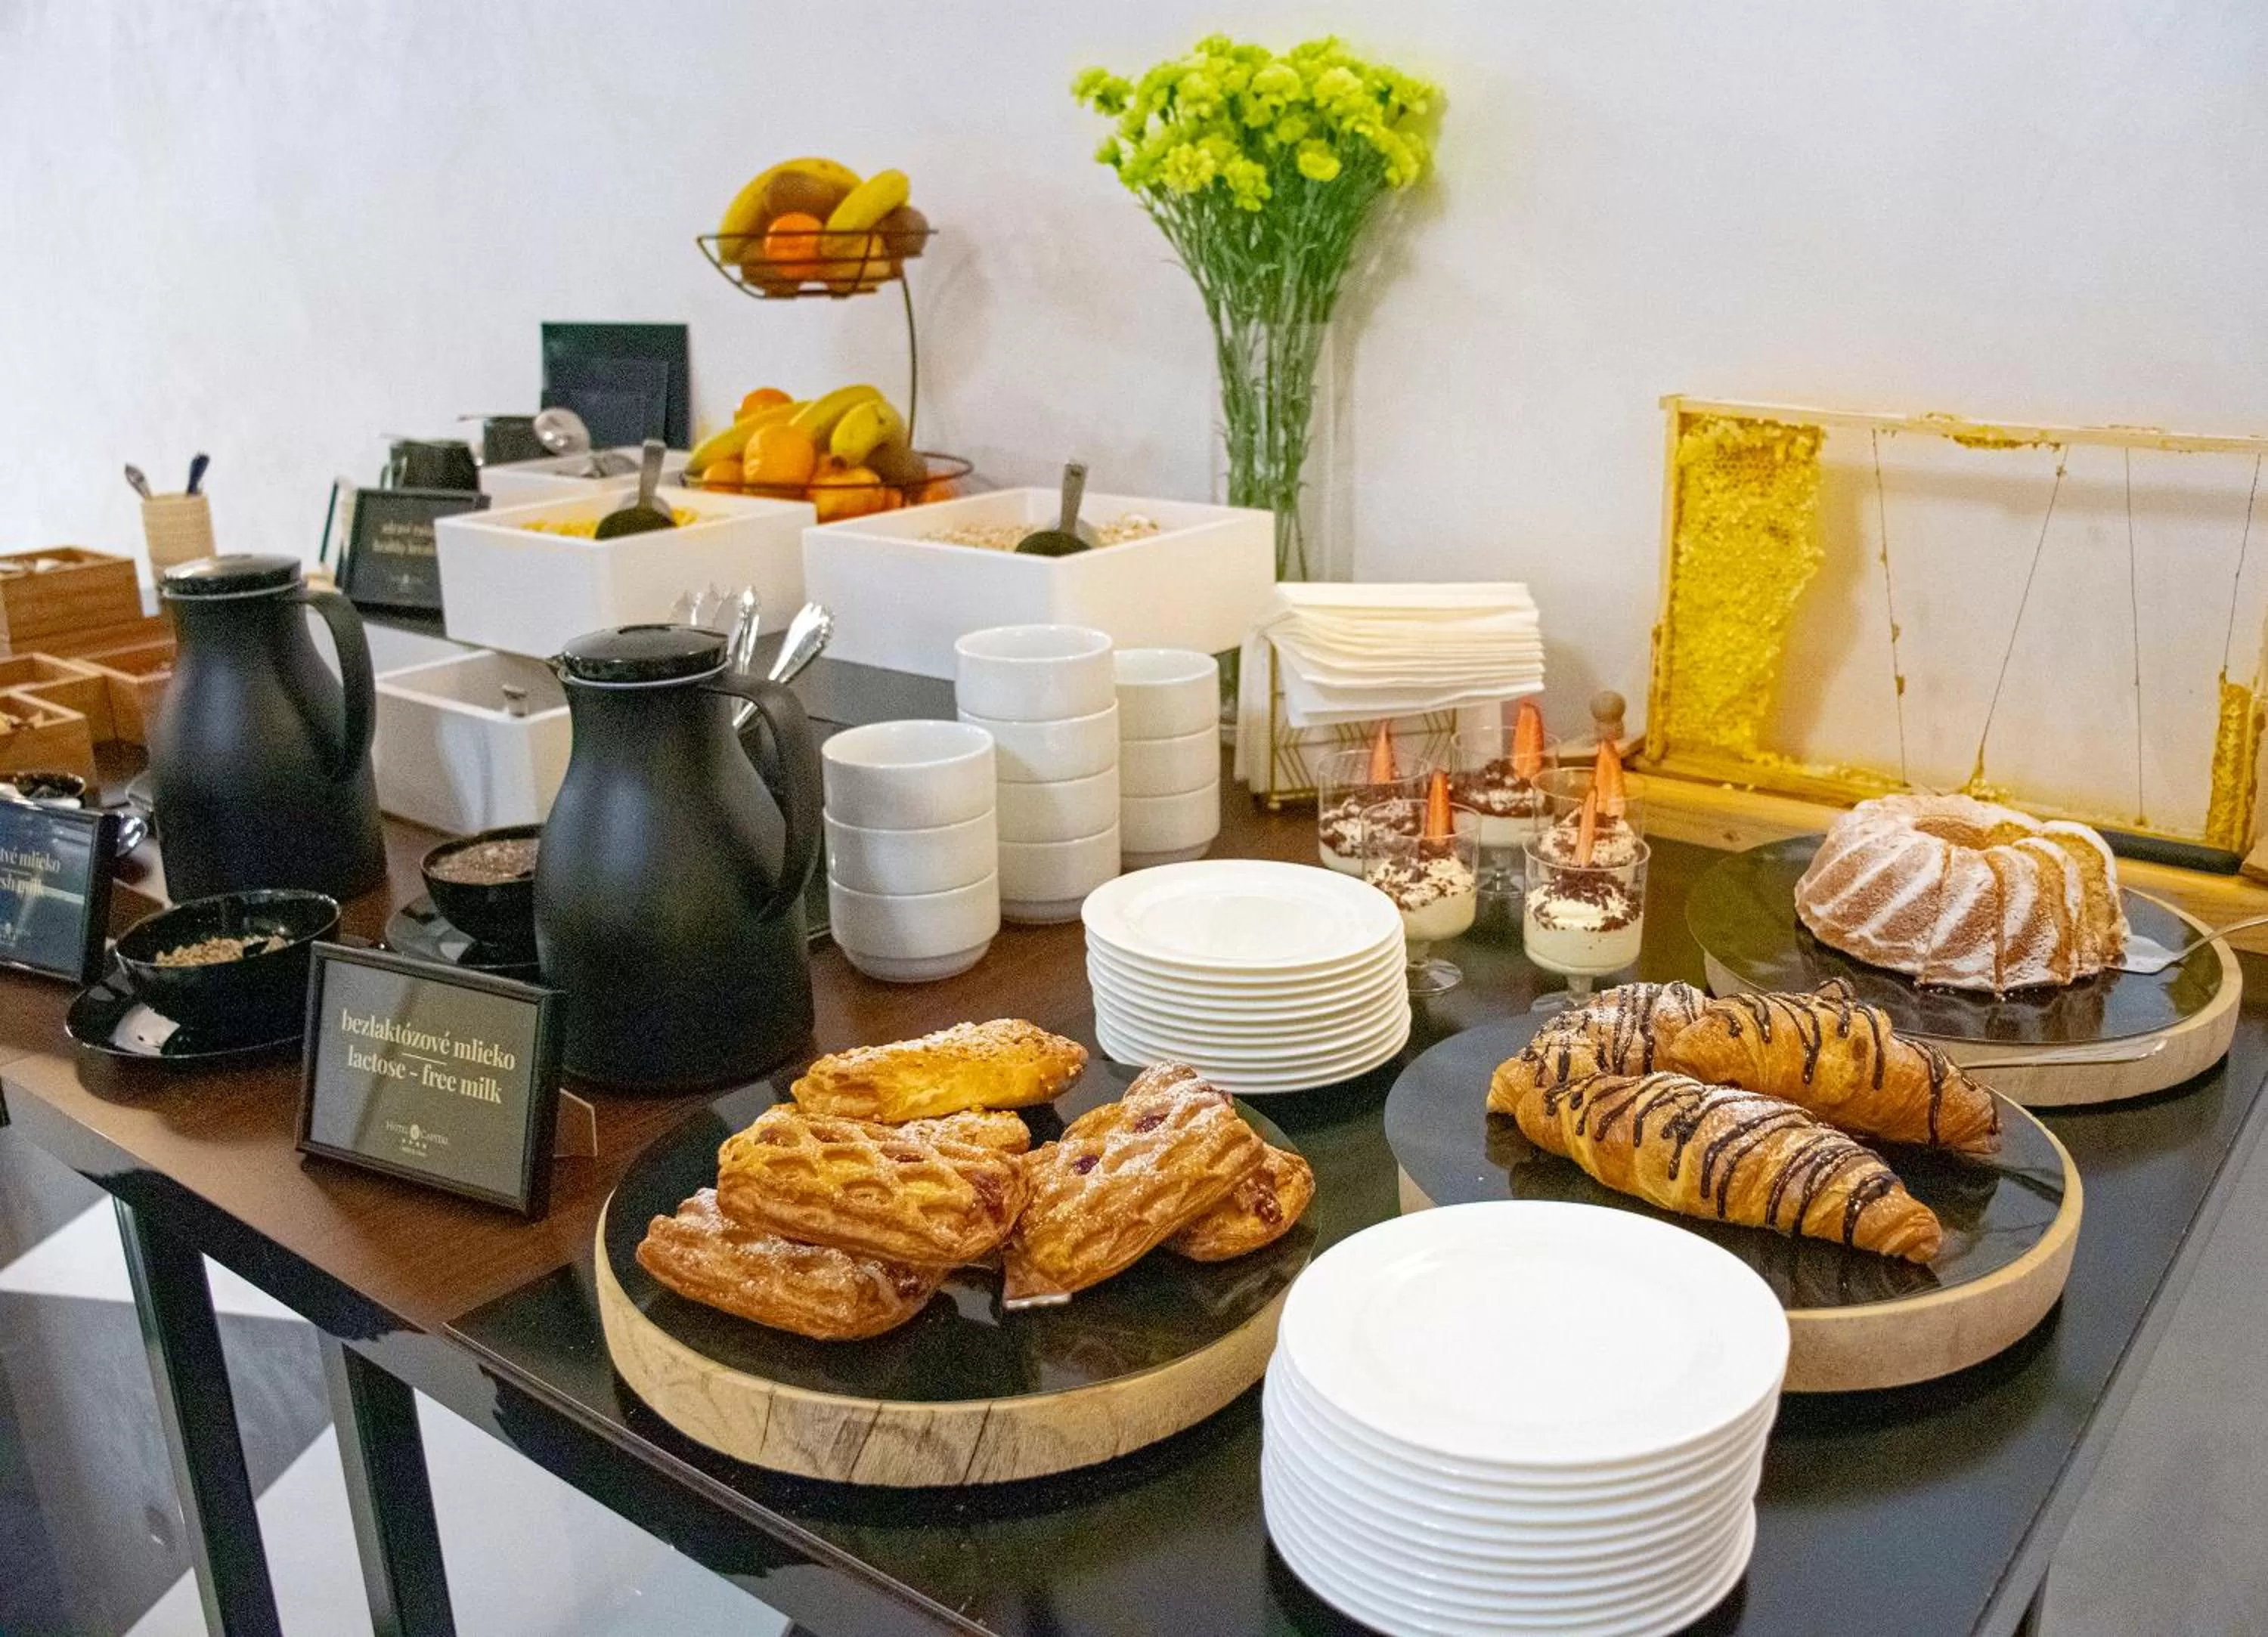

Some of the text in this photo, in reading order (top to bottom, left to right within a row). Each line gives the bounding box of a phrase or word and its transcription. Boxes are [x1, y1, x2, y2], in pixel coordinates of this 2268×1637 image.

[341, 1007, 516, 1071] bezlaktózové mlieko
[348, 1045, 406, 1079] lactose
[421, 1064, 457, 1092] free
[460, 1077, 503, 1105] milk
